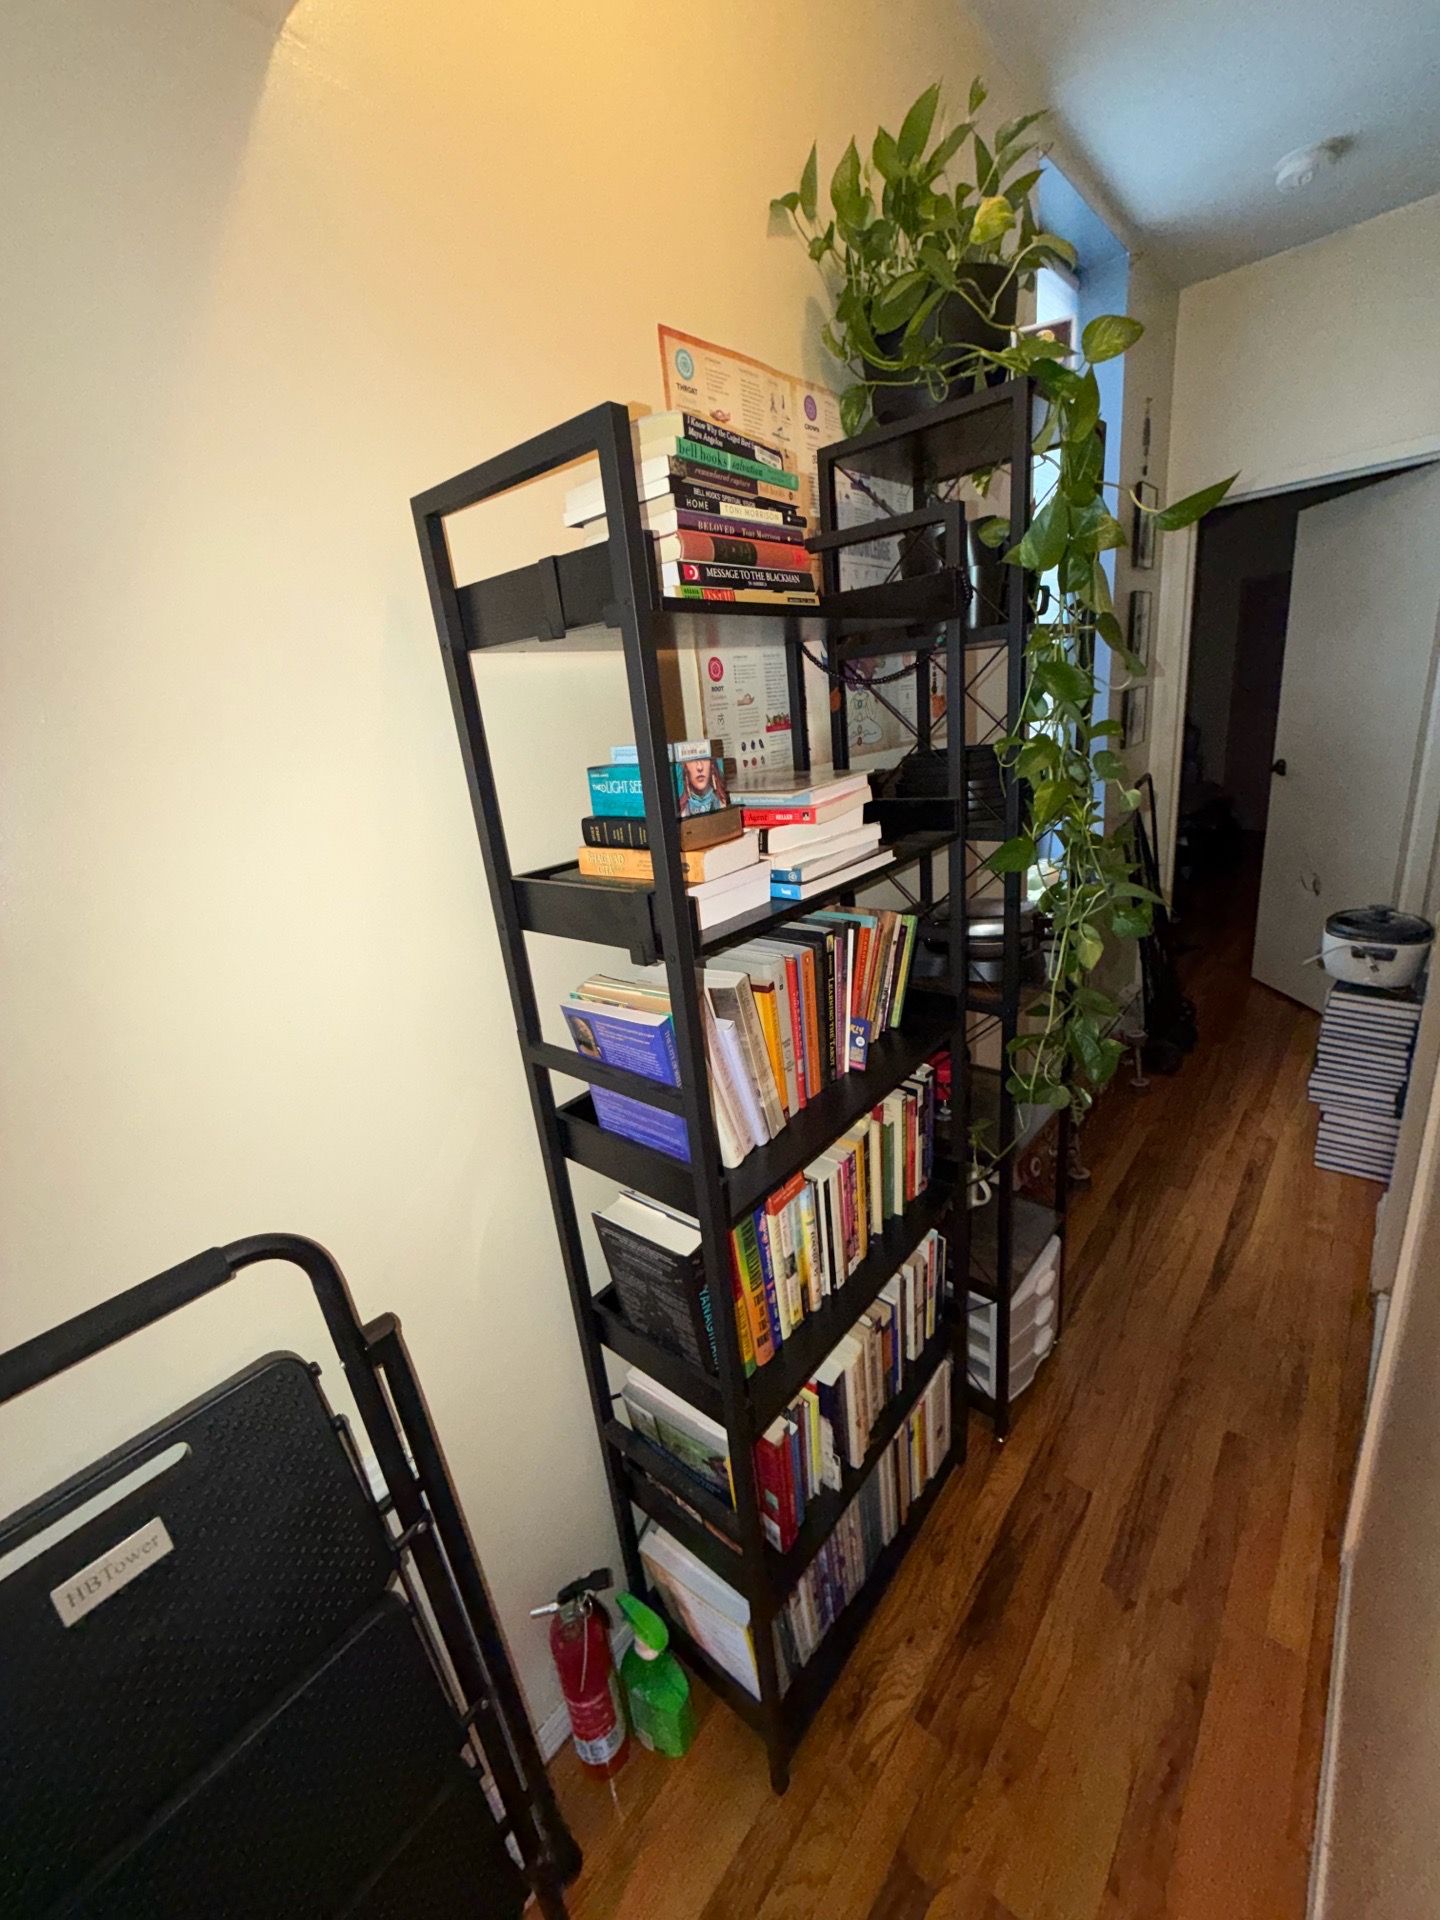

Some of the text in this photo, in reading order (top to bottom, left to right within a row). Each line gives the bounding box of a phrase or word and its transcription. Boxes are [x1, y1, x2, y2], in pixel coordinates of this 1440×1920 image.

[675, 382, 698, 395] THROAT
[688, 427, 723, 448] Maya Angelou
[690, 416, 706, 430] Know
[706, 423, 717, 437] Why
[717, 429, 726, 439] the
[679, 441, 698, 458] bell
[700, 448, 728, 468] hooks
[693, 487, 705, 497] BELL
[686, 498, 780, 521] HOME TONI MORRISON
[698, 521, 735, 535] BELOVED
[742, 527, 755, 538] Toni
[706, 567, 800, 584] MESSAGE TO THE BLACKMAN
[65, 1535, 159, 1608] HBTower
